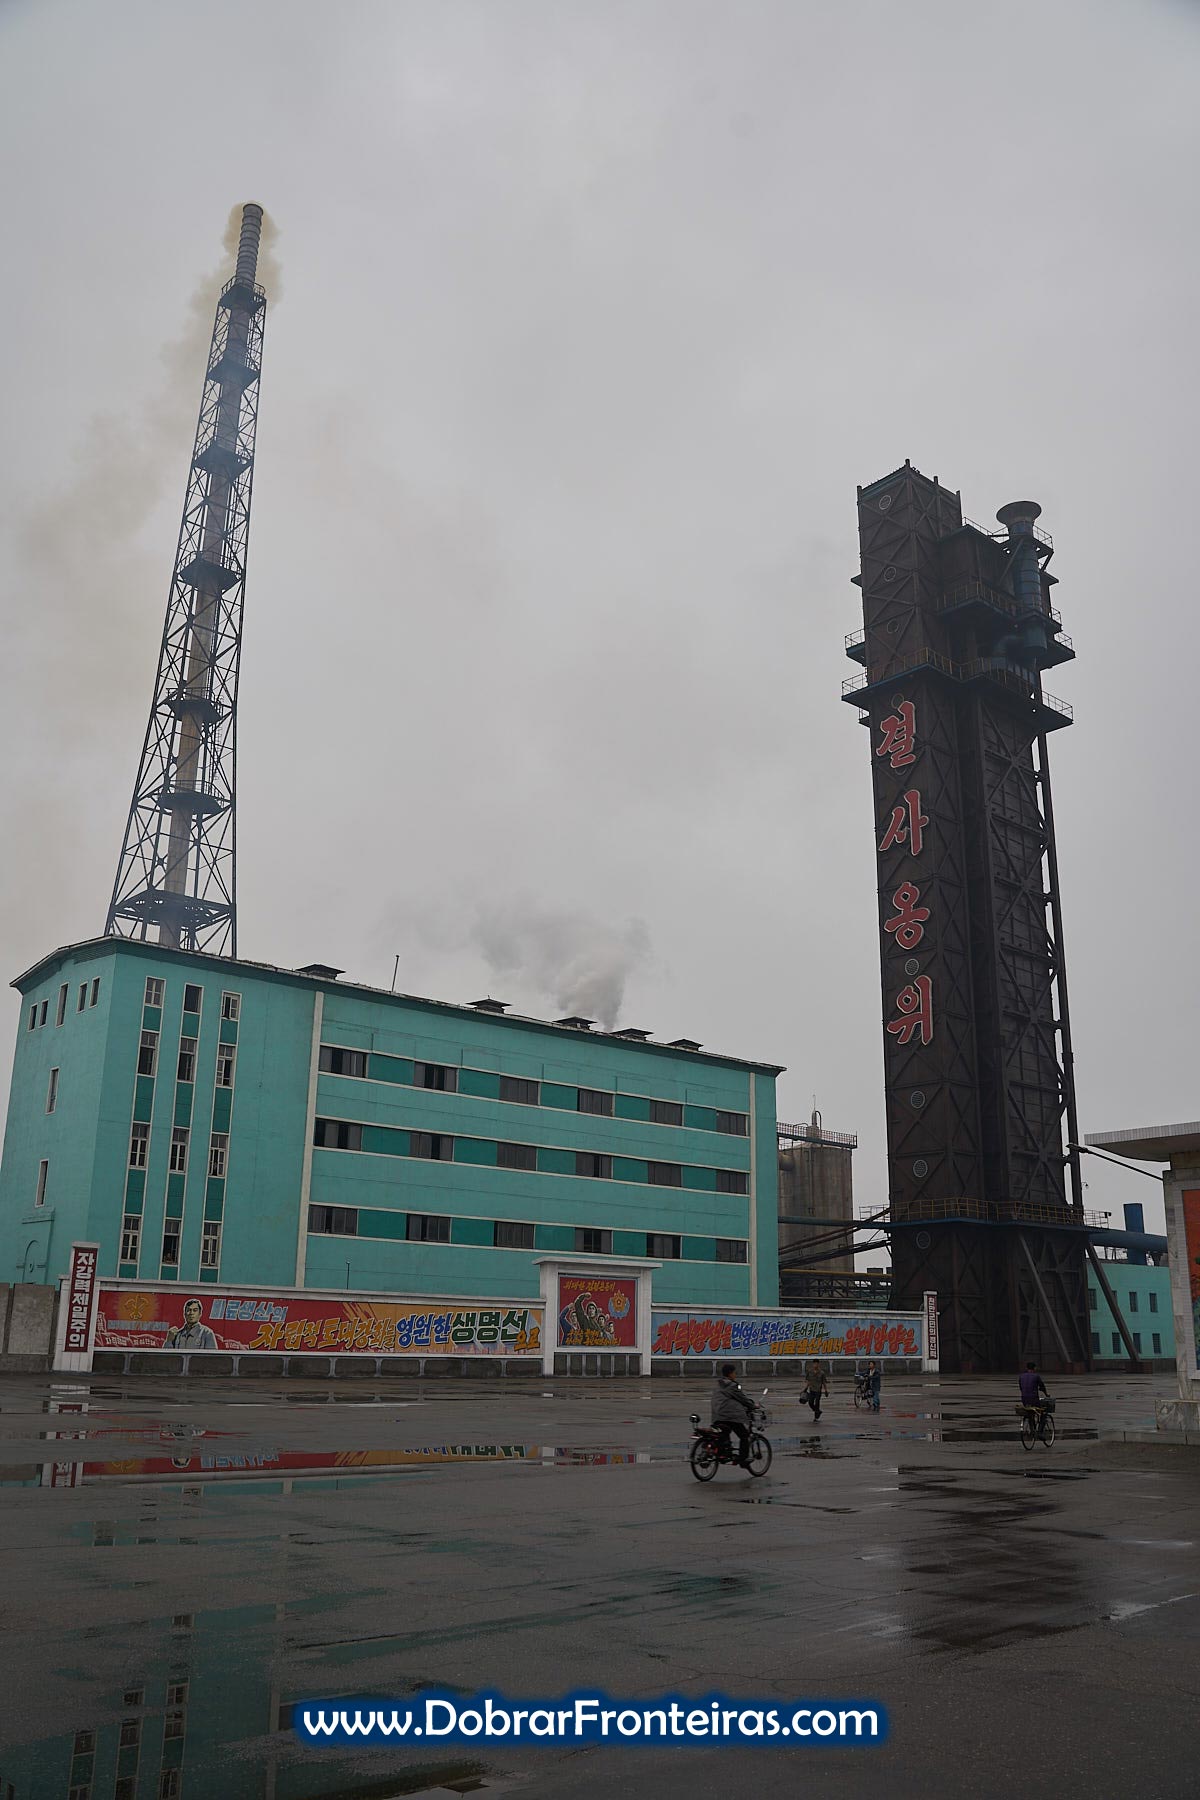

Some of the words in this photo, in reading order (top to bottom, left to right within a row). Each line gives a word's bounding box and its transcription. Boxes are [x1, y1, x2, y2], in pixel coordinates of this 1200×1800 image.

[876, 700, 935, 1046] 결사옹위
[68, 1252, 95, 1348] 자강력제일주의
[209, 1298, 288, 1322] 비료생산의
[396, 1313, 453, 1348] 영원한
